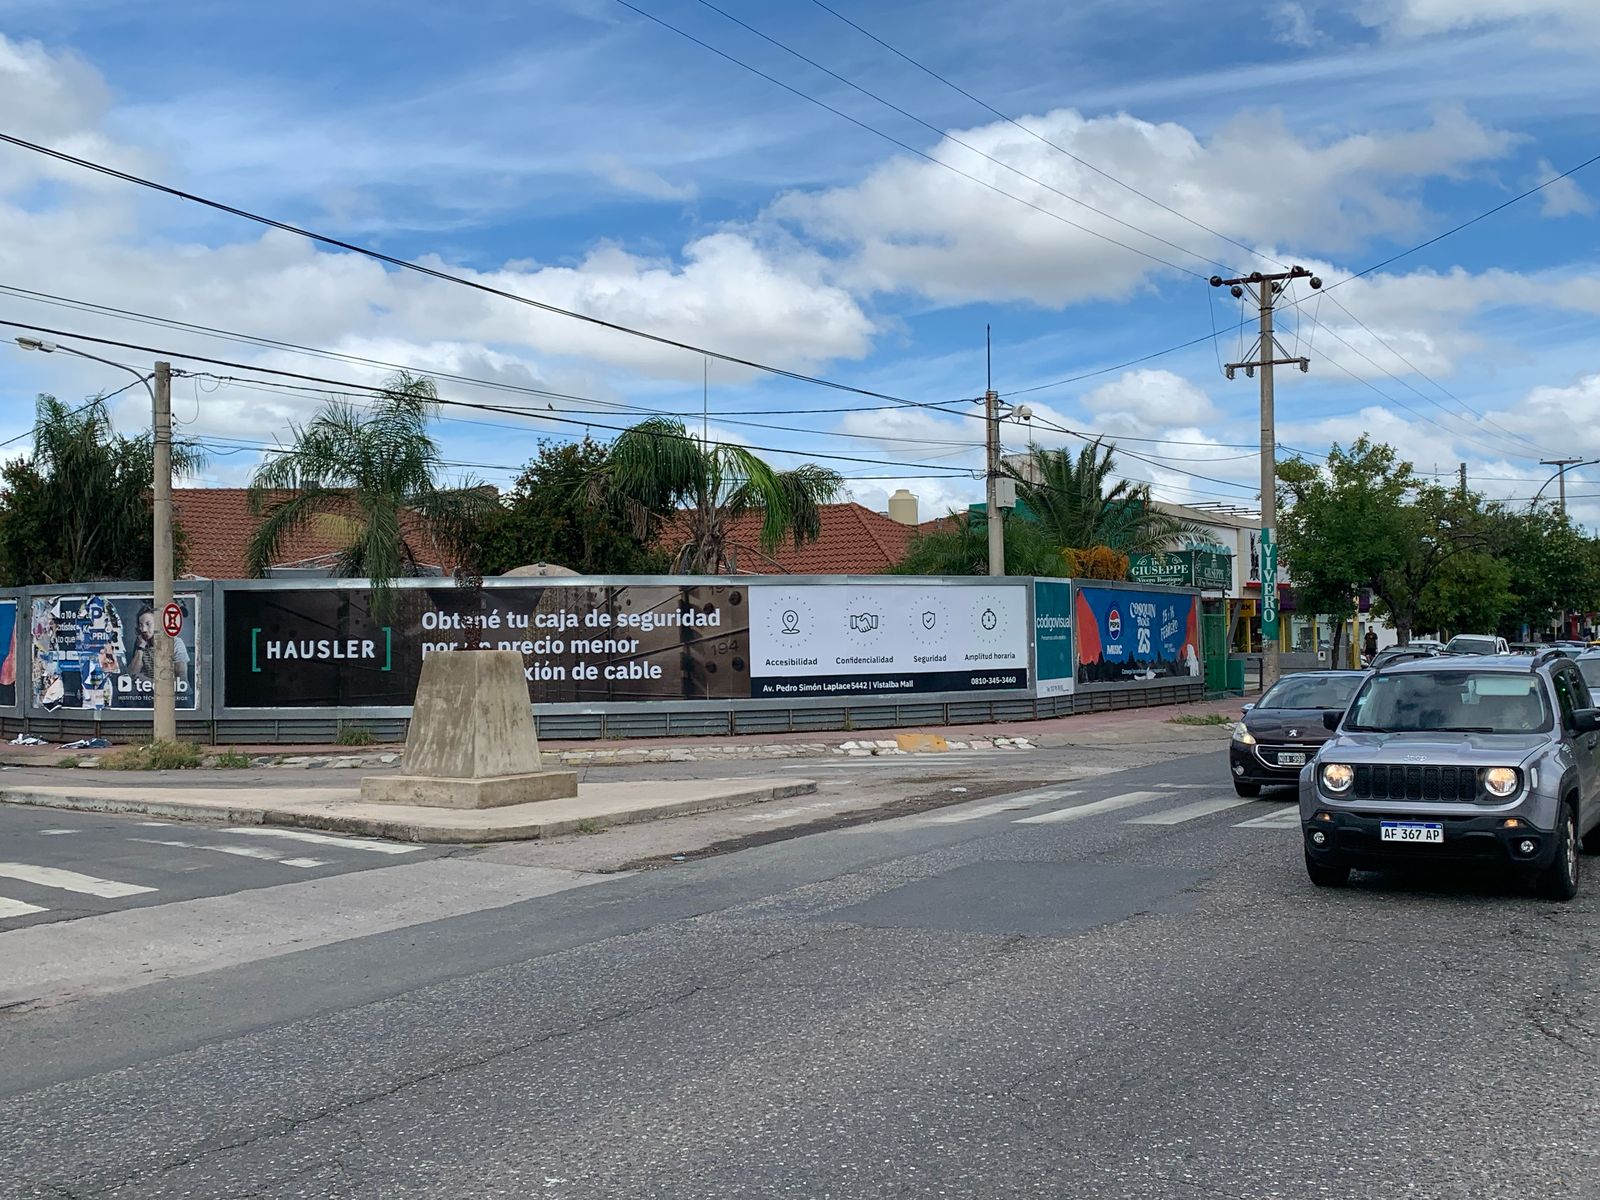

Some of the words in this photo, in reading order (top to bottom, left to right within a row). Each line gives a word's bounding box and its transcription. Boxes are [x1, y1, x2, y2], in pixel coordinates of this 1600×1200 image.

[1131, 564, 1189, 576] GIUSEPPE
[1263, 543, 1276, 623] VIVERO
[421, 608, 500, 630] Obtené
[506, 611, 529, 628] tu
[535, 609, 579, 632] caja
[584, 608, 612, 628] de
[616, 608, 720, 631] seguridad
[266, 640, 376, 660] HAUSLER
[498, 635, 565, 654] precio
[570, 639, 640, 654] menor
[765, 657, 818, 666] Accesibilidad
[835, 656, 894, 665] Confidencialidad
[913, 654, 947, 664] Seguridad
[964, 652, 992, 662] Amplitud
[993, 652, 1016, 660] horaria
[523, 660, 566, 681] xión
[571, 661, 598, 680] de
[603, 661, 662, 680] cable
[762, 684, 774, 693] Av.
[775, 684, 798, 692] Pedro
[798, 682, 822, 692] Simón
[823, 682, 851, 692] Laplace
[850, 681, 868, 689] 5442
[872, 680, 899, 689] Vistalba
[900, 679, 914, 688] Mall
[970, 676, 1017, 685] 0810-345-3460
[1384, 828, 1397, 839] AF
[1401, 829, 1422, 840] 367
[1425, 829, 1440, 840] AP
